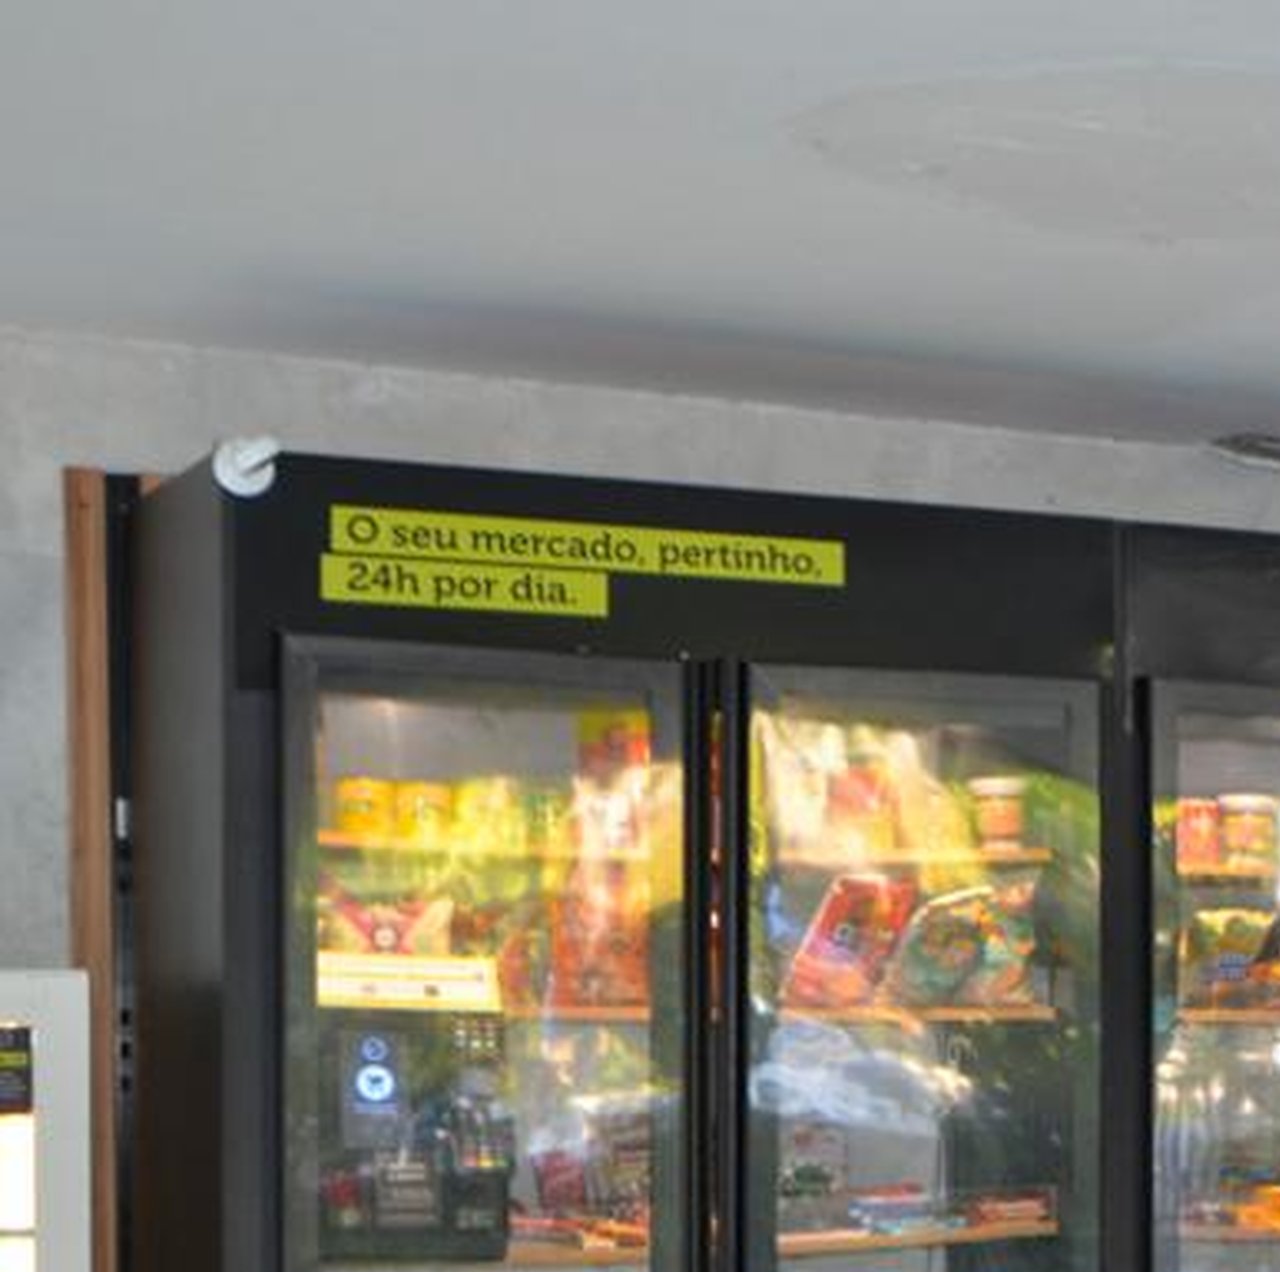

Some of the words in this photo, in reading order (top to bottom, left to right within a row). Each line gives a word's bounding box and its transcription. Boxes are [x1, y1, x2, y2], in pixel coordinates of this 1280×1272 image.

[347, 515, 381, 545] O
[391, 523, 460, 551] seu
[347, 562, 418, 595] 24h
[434, 574, 498, 605] por
[511, 573, 578, 607] dia.
